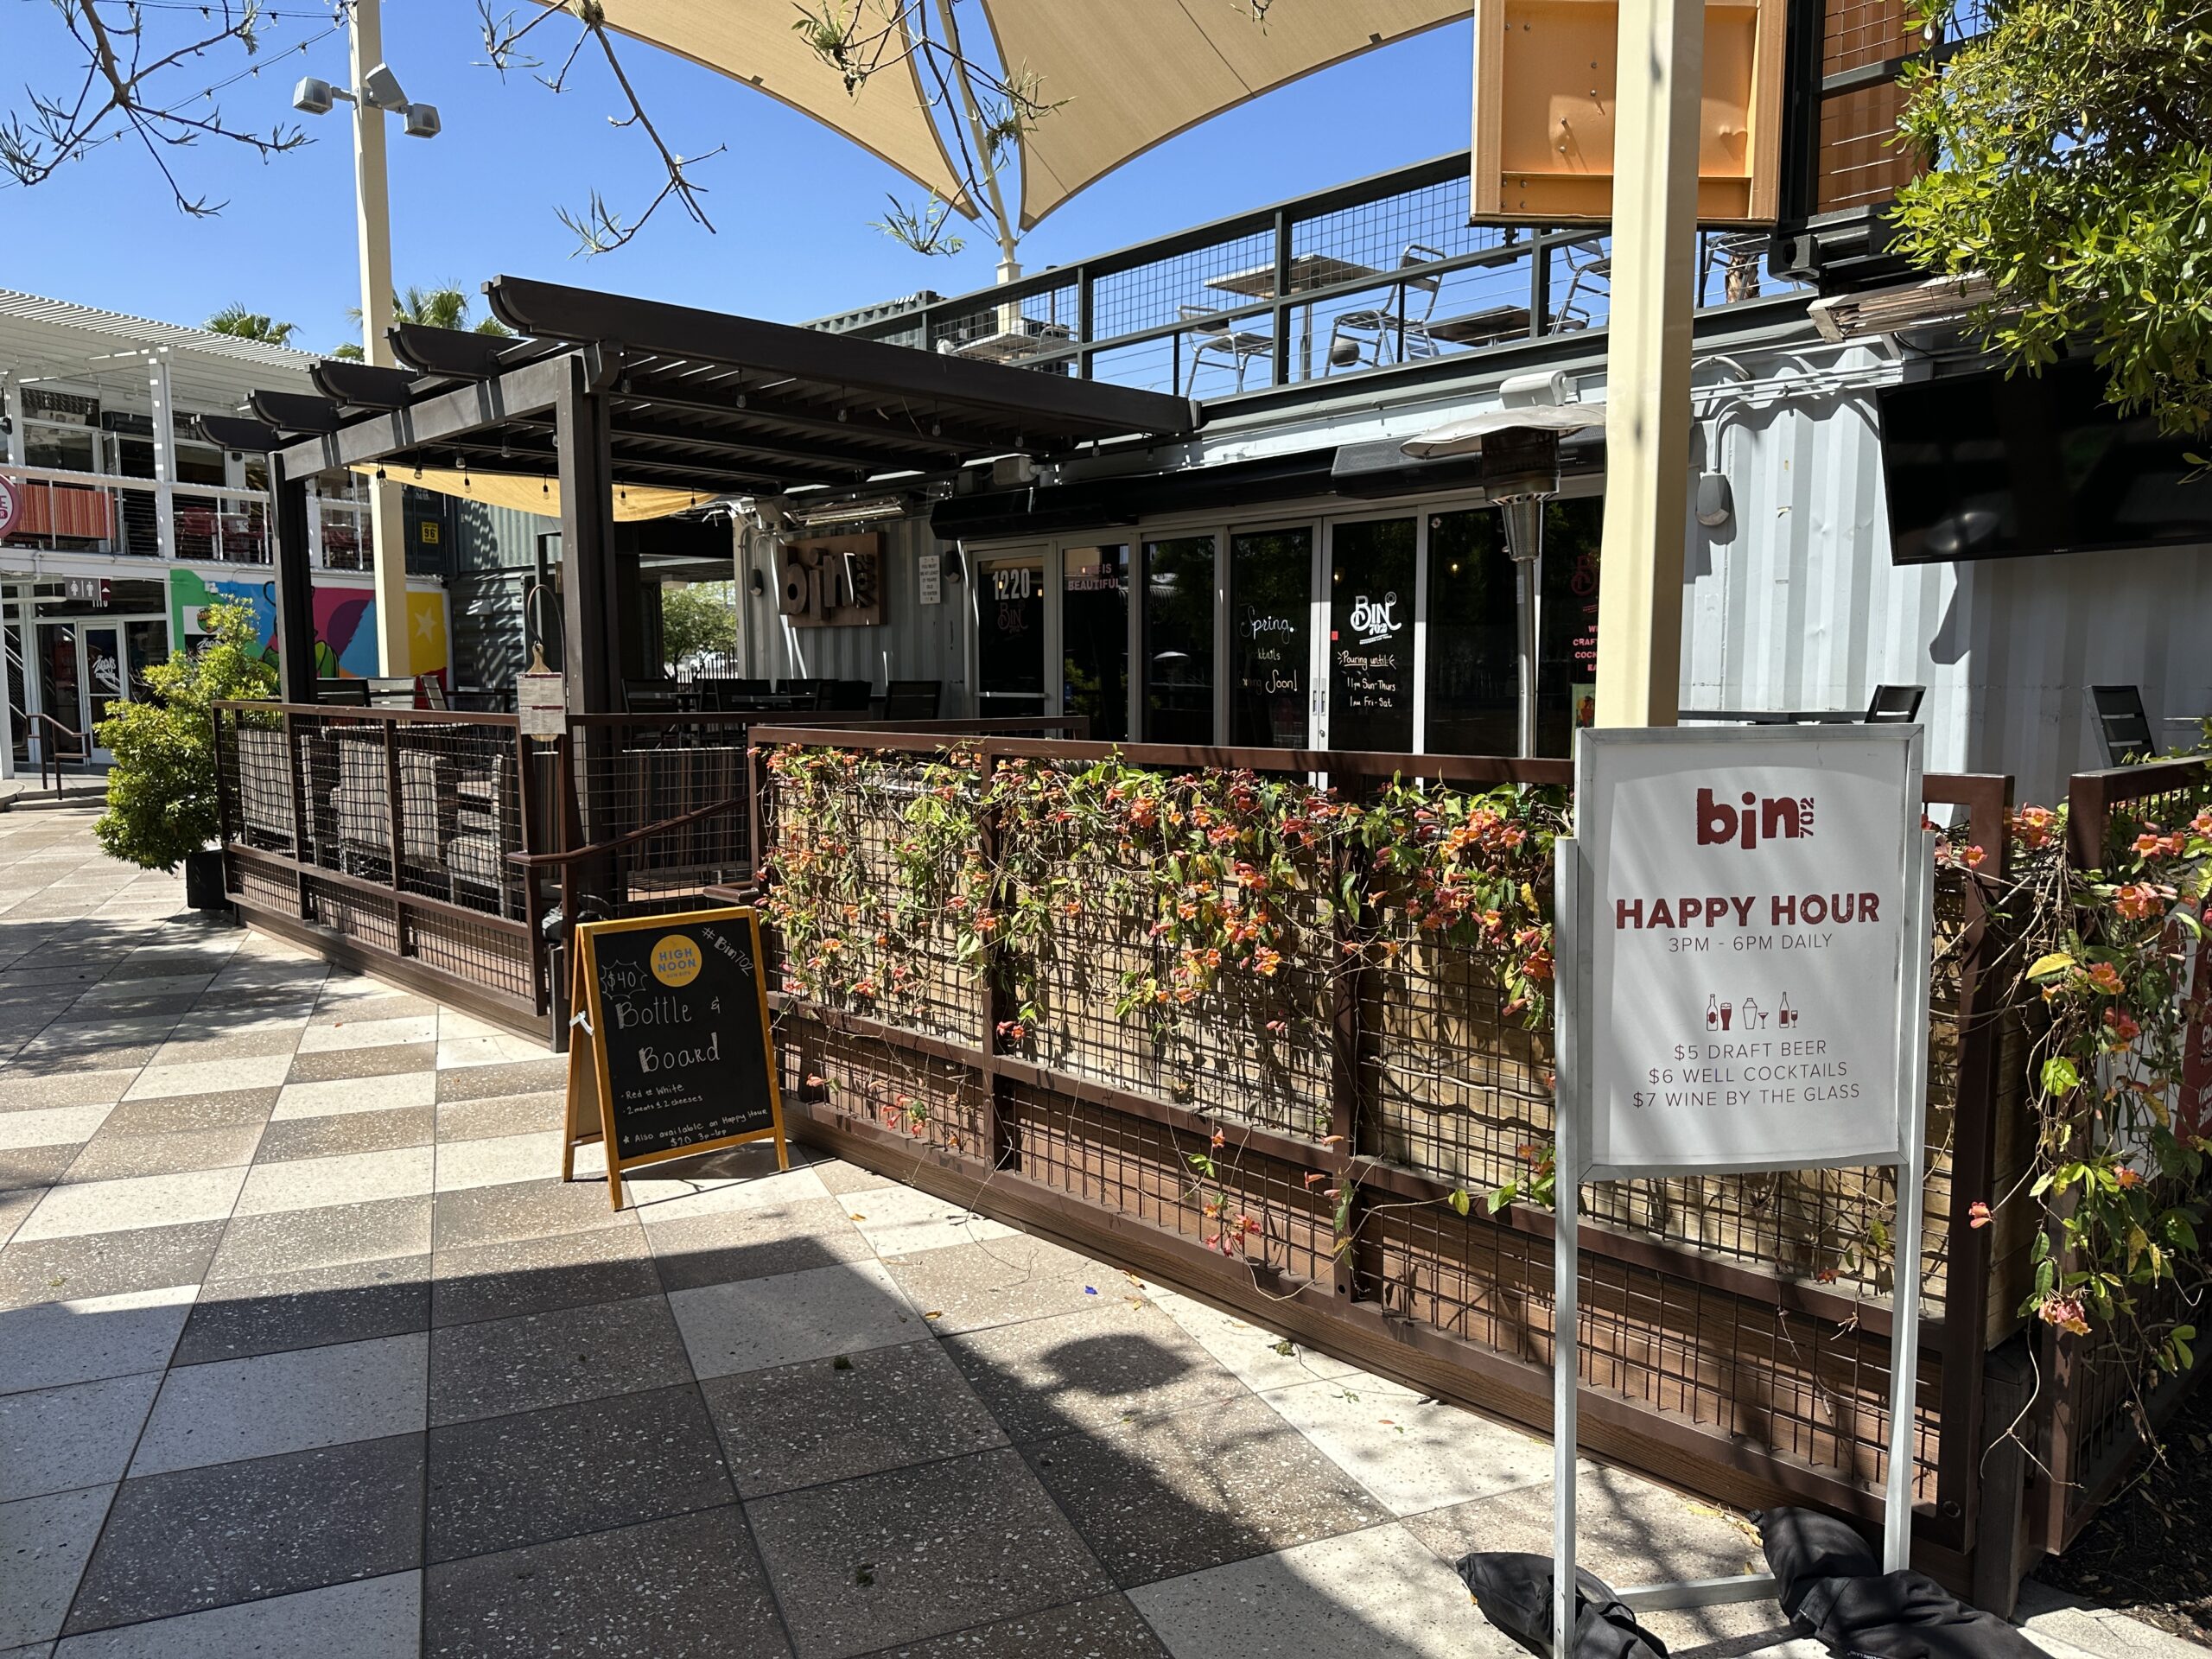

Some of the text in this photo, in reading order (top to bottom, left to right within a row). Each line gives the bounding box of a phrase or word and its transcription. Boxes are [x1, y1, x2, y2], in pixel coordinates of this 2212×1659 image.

[1102, 563, 1112, 575] IS
[778, 545, 854, 620] bin
[992, 567, 1030, 601] 1220
[1068, 577, 1122, 591] BEAUTIFUL
[1350, 591, 1402, 632] BIN
[1369, 623, 1388, 636] 702
[1342, 650, 1389, 671] Pouring until
[1265, 669, 1298, 694] Soon!
[1696, 787, 1815, 849] bin 702
[1616, 893, 1880, 930] HAPPY HOUR
[1669, 937, 1709, 953] 3PM
[1733, 935, 1772, 951] 6PM
[1782, 933, 1833, 949] DAILY
[658, 948, 692, 962] HIGH
[658, 959, 696, 973] NOON
[607, 970, 637, 992] $40
[615, 995, 721, 1029] Bottle &
[1674, 1039, 1827, 1062] $5 DRAFT BEER
[1649, 1061, 1847, 1085] $6 WELL COCKTAILS
[655, 1084, 684, 1096] White
[1632, 1083, 1860, 1109] $7 WINE BY THE GLASS
[626, 1105, 634, 1115] 2
[671, 1095, 703, 1106] cheeses
[634, 1133, 654, 1143] Also
[659, 1122, 704, 1139] available
[721, 1113, 747, 1124] Happy
[670, 1136, 692, 1147] $20
